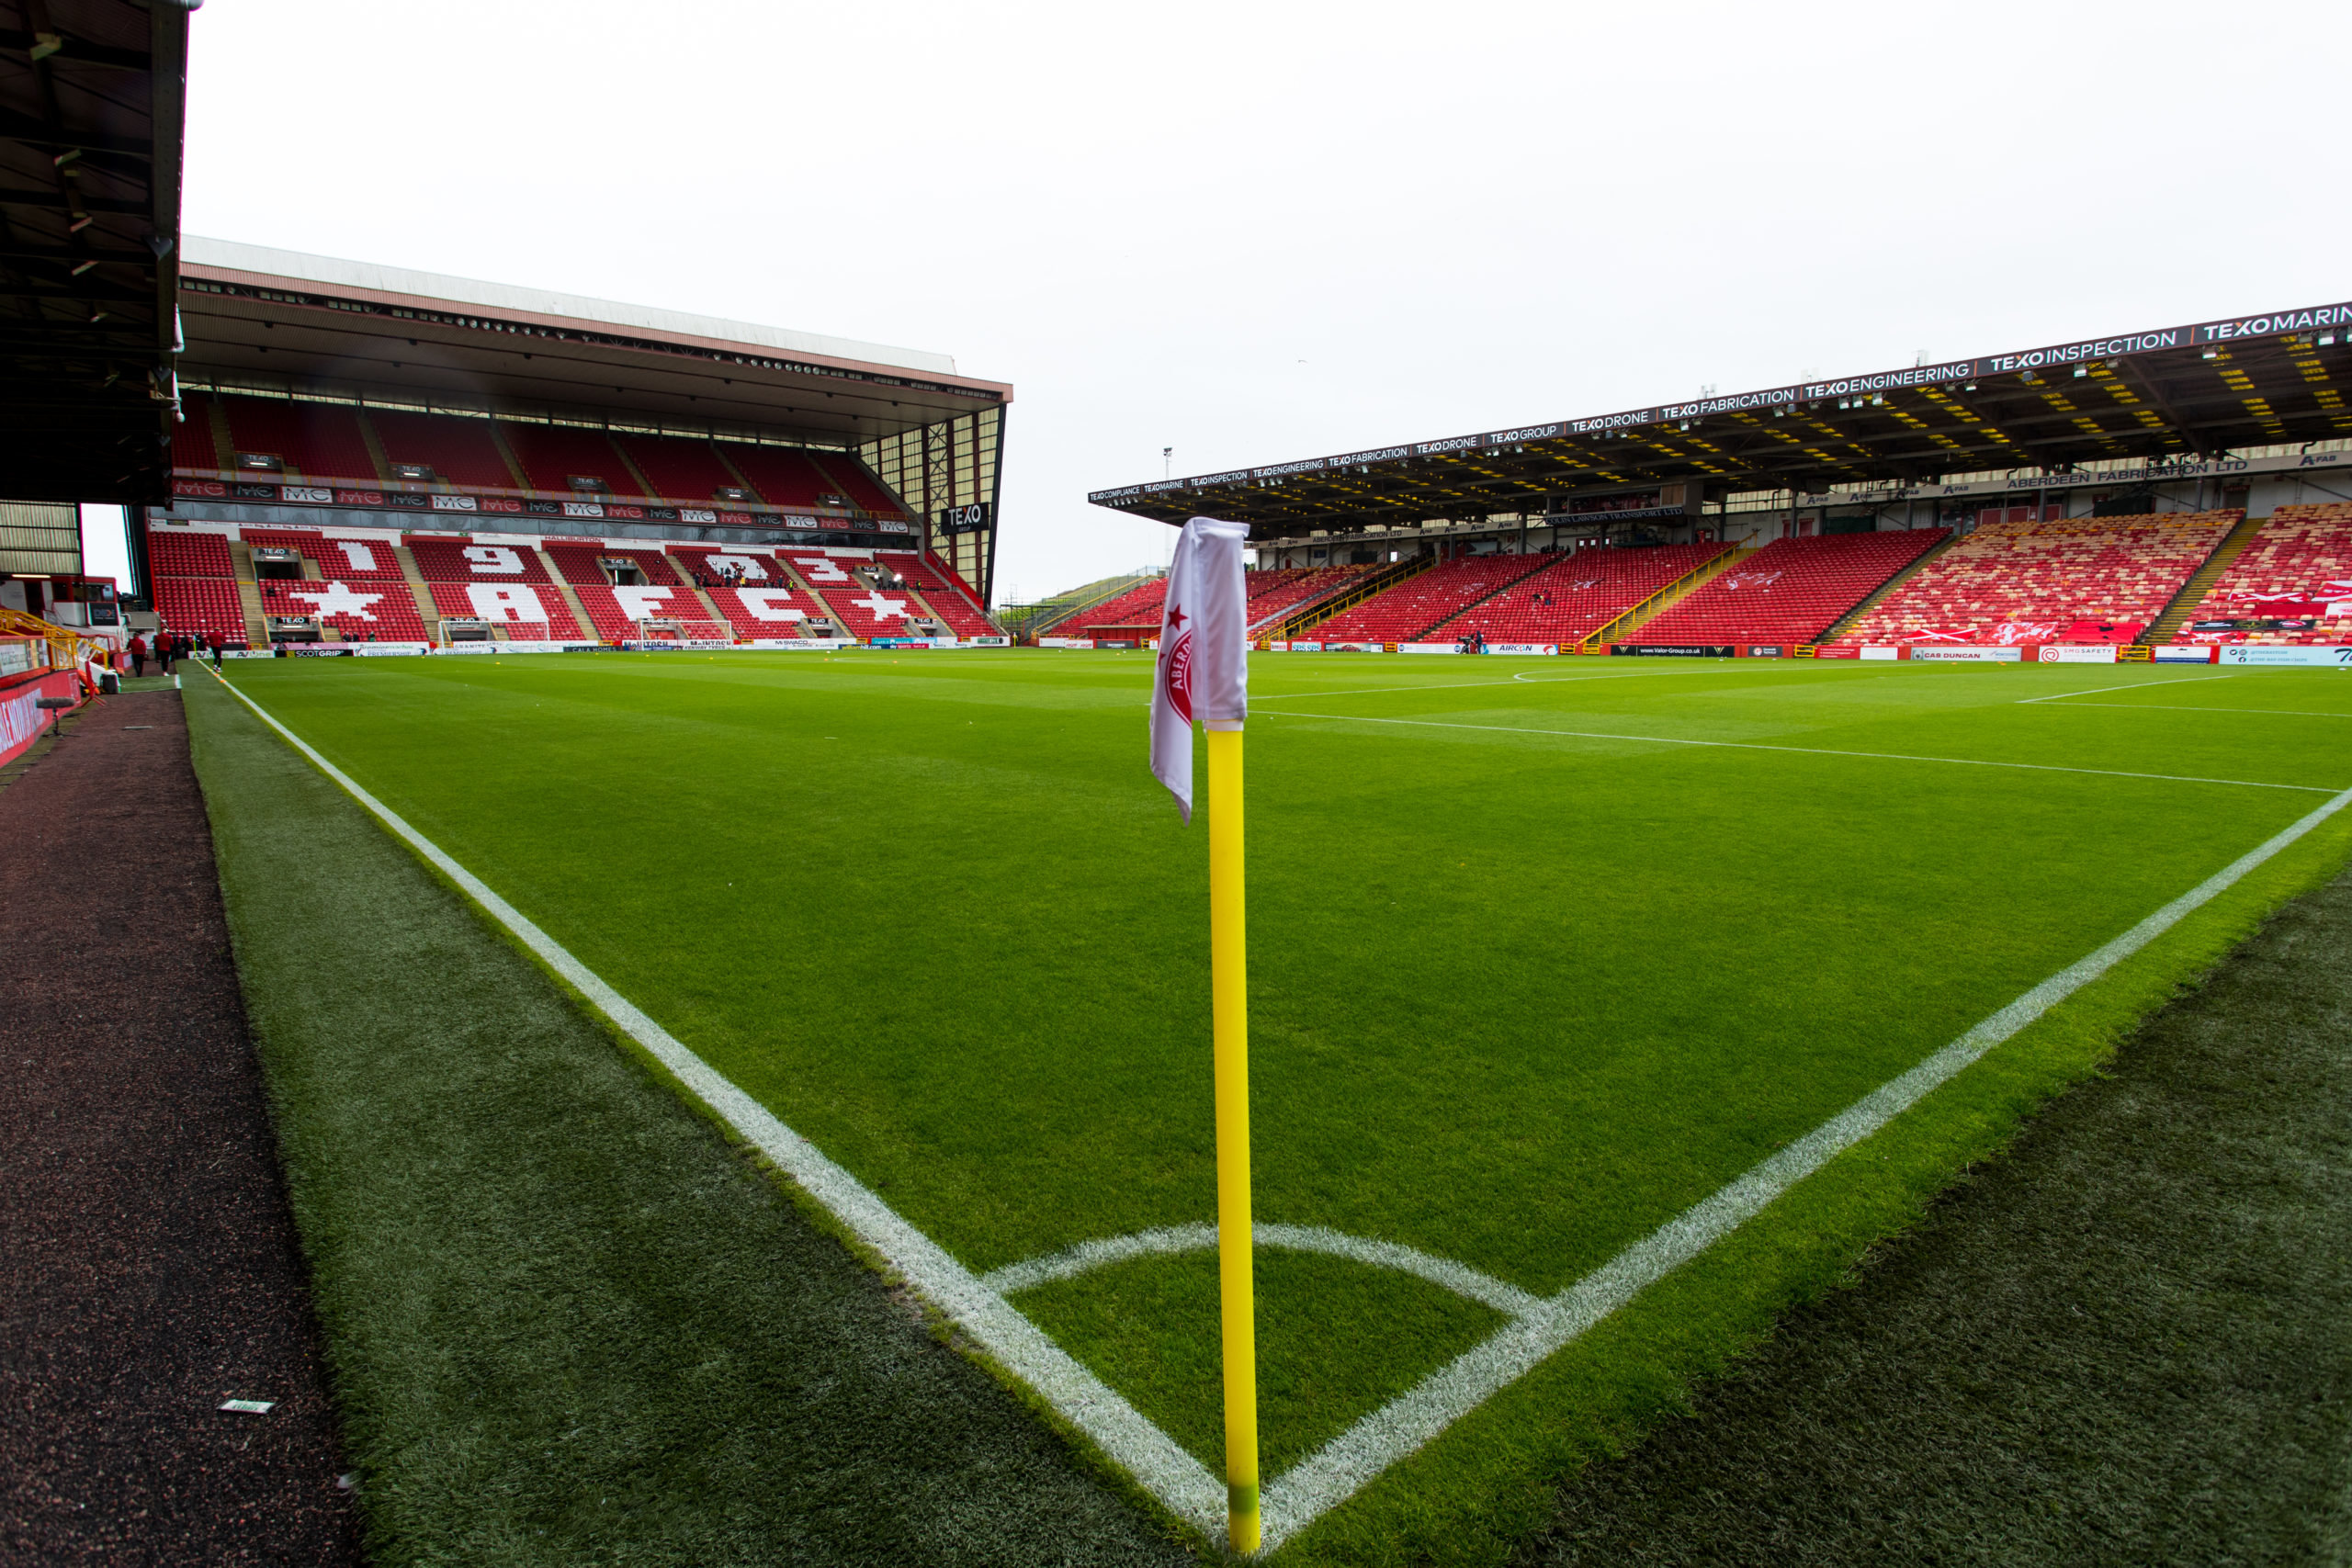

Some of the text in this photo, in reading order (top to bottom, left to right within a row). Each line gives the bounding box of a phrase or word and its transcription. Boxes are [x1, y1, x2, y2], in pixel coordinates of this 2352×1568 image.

[2204, 319, 2270, 341] TEXO
[1991, 331, 2177, 371] TEXO INSPECTION
[1805, 364, 1970, 398] TEXO ENGINEERING
[1663, 389, 1794, 419] TEXO FABRICATION
[1572, 412, 1648, 433] TEXO DRONE
[1417, 436, 1476, 454] TEXO DRONE
[1491, 425, 1556, 444] TEXO GROUP
[1329, 446, 1408, 467] TEXO FABRICATION
[1191, 471, 1247, 487] TEXO INSPECTION
[1253, 460, 1324, 478] TEXO ENGINEERING
[2007, 460, 2247, 488] ABERDEEN FABRICATION LTD
[1091, 486, 1140, 502] TEXO COMPLIANCE
[1144, 480, 1183, 492] TEXO MARINE
[948, 504, 981, 525] TEXO
[1573, 513, 1608, 523] LAWSON
[1610, 510, 1662, 520] TRANSPORT
[1664, 507, 1682, 515] LTD
